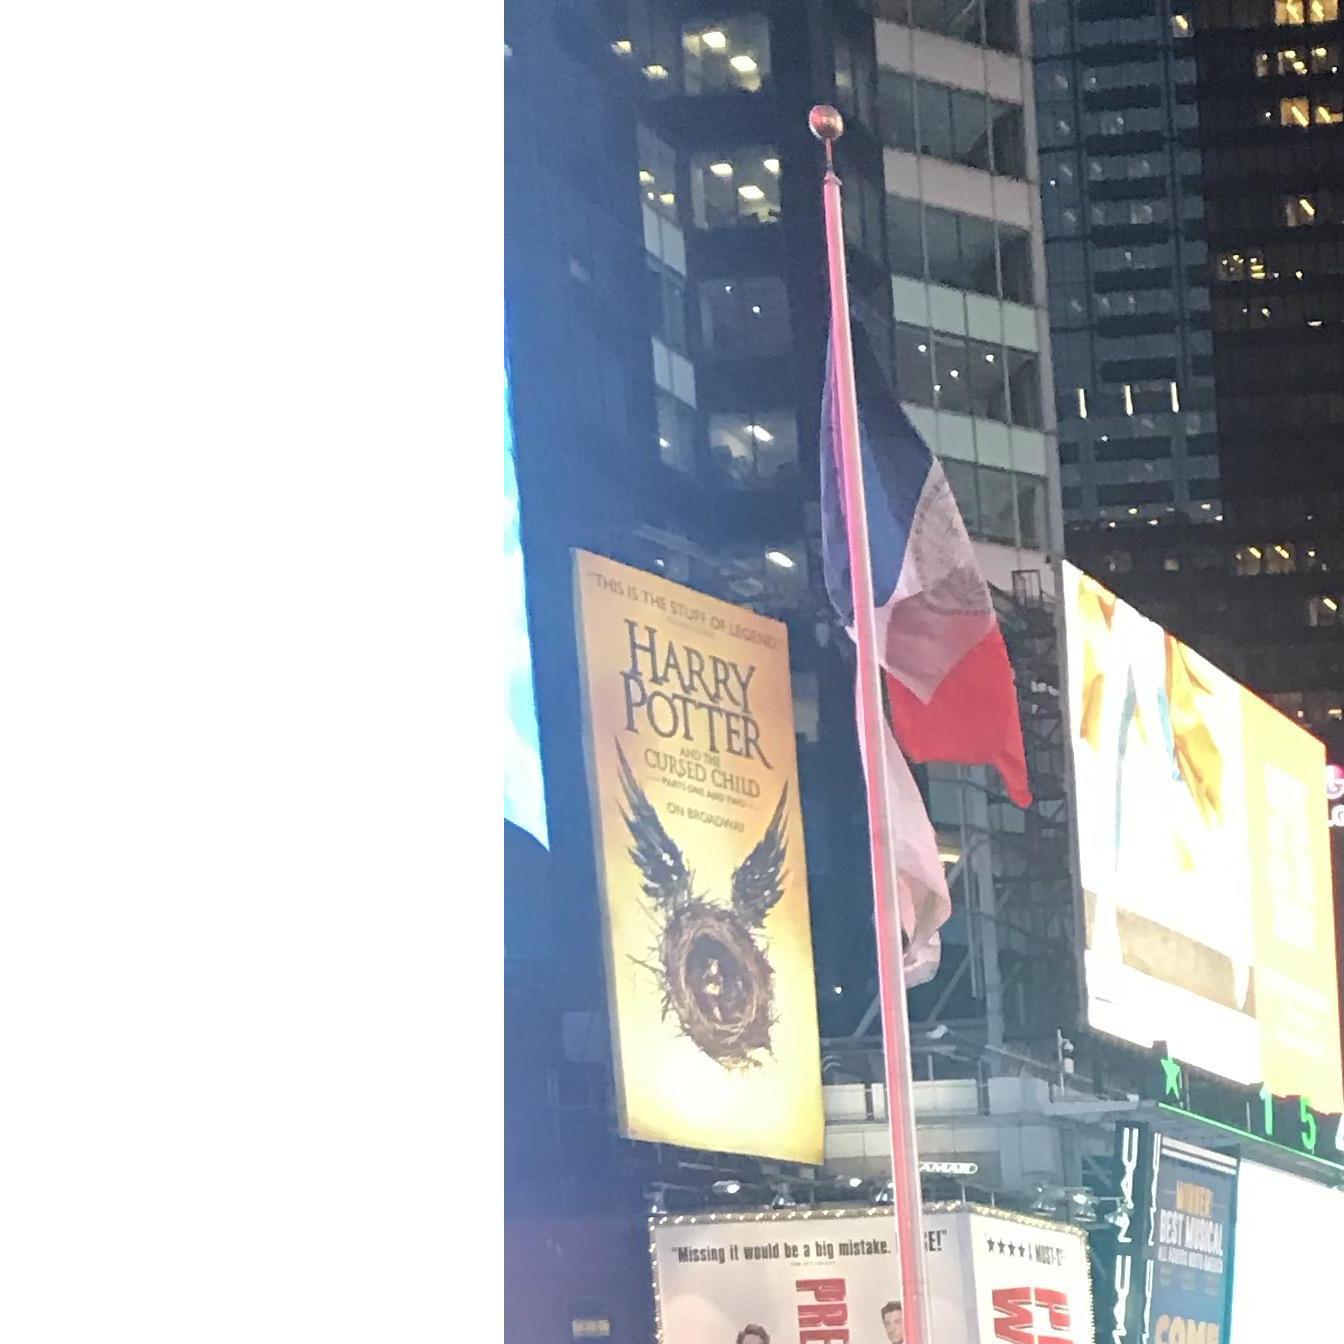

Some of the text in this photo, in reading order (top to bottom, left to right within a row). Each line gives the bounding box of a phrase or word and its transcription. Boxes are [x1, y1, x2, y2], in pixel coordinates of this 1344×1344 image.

[627, 585, 639, 601] IS
[642, 590, 667, 612] THE
[670, 601, 707, 625] STUFF
[710, 615, 726, 630] OF
[624, 617, 757, 715] HARRY
[620, 671, 774, 770] POTTER
[644, 748, 760, 799] CURSED CHILD
[703, 752, 721, 768] THE
[730, 1244, 739, 1260] it
[743, 1242, 780, 1260] would
[784, 1241, 799, 1258] be
[803, 1243, 811, 1257] a
[816, 1240, 834, 1260] big
